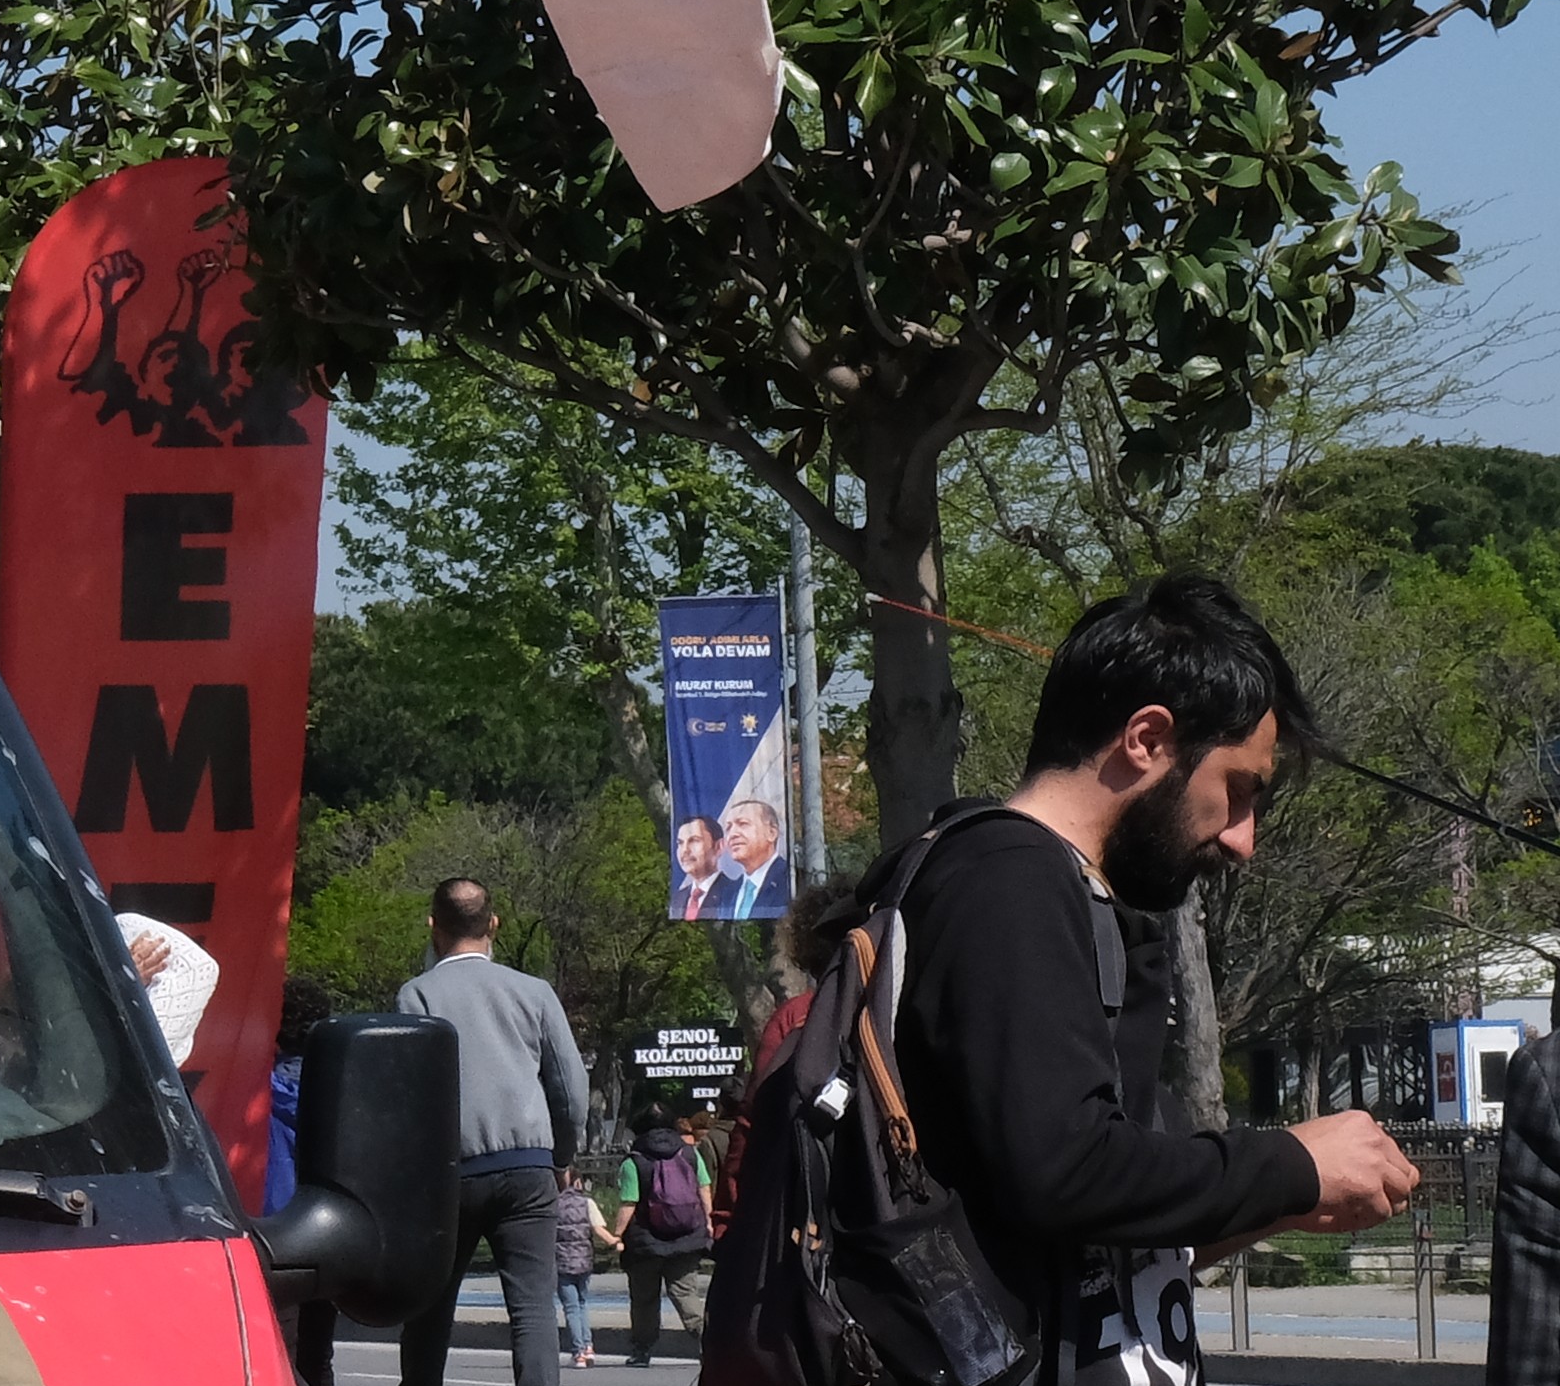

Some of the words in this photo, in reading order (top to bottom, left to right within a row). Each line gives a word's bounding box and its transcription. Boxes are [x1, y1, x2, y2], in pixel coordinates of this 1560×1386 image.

[671, 645, 713, 658] YOLA
[716, 645, 770, 657] DEVAM
[675, 680, 712, 690] MURAT
[658, 1029, 720, 1048] ŞENOL
[634, 1044, 743, 1064] KOLCUOĞLU
[646, 1064, 735, 1078] RESTAURANT
